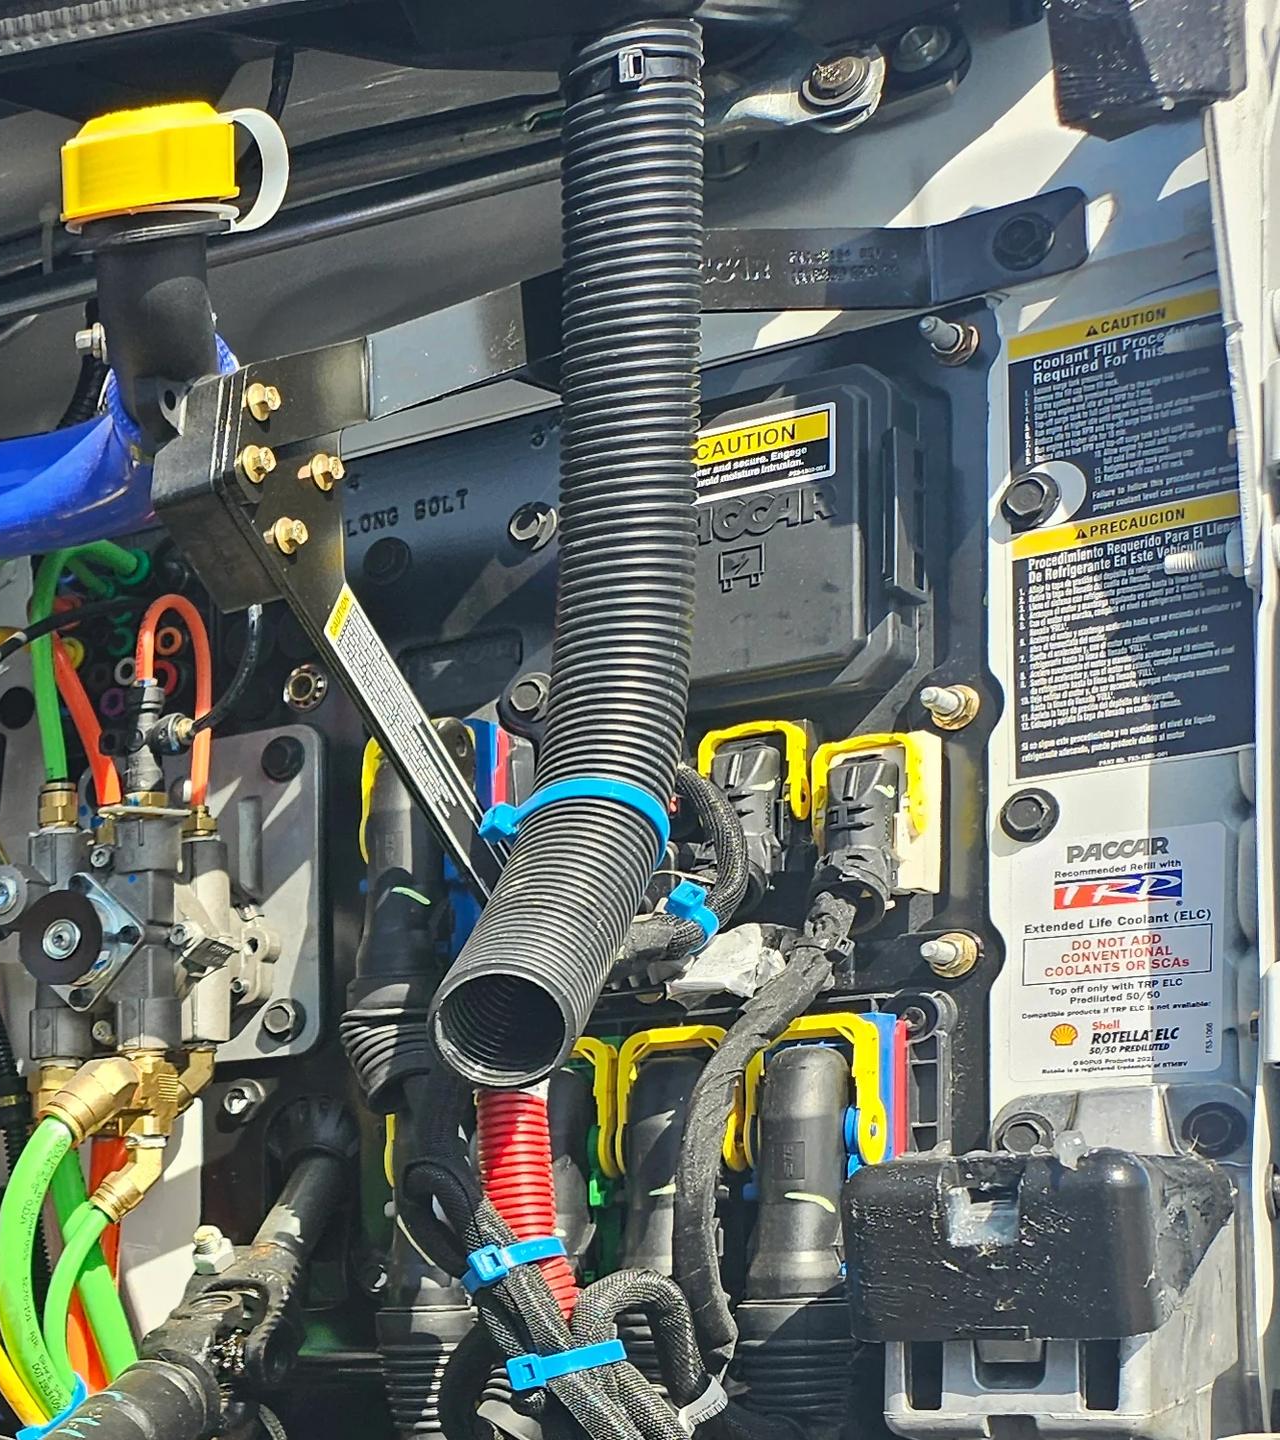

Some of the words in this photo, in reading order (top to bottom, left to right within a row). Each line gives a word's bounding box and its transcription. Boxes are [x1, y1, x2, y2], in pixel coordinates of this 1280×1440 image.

[1101, 307, 1166, 333] CAUTION
[1033, 347, 1089, 371] Coolant
[1093, 342, 1117, 356] Fill
[1123, 324, 1199, 349] Proce
[1033, 358, 1099, 385] Required
[1104, 353, 1128, 368] For
[1133, 345, 1164, 361] This
[696, 424, 796, 460] CAUTION
[713, 461, 731, 473] and
[771, 447, 807, 462] Engage
[720, 465, 760, 482] moisture
[345, 506, 399, 538] LONG
[697, 483, 838, 547] ACCAR
[1090, 508, 1185, 537] PRECAUCION
[1028, 547, 1103, 571] Procedimiento
[1107, 537, 1162, 556] Requerido
[1165, 529, 1190, 543] Para
[1193, 526, 1203, 538] El
[1207, 521, 1239, 535] Llena
[1028, 570, 1043, 585] De
[1045, 560, 1111, 580] Refrigerante
[1114, 555, 1127, 567] En
[1131, 551, 1153, 564] Este
[1067, 836, 1169, 864] PACCAR
[1054, 864, 1126, 879] Recommended
[1130, 862, 1156, 872] Refill
[1159, 859, 1182, 869] with
[1063, 874, 1182, 906] TRP
[1024, 920, 1084, 934] Extended
[1089, 917, 1112, 928] Life
[1117, 912, 1169, 926] Coolant
[1174, 909, 1211, 923] (ELC)
[1061, 946, 1173, 964] CONVENTIONAL
[1072, 940, 1094, 951] DO
[1097, 937, 1126, 948] NOT
[1131, 934, 1162, 946] ADD
[1045, 963, 1120, 977] COOLANTS
[1126, 960, 1146, 971] OR
[1151, 957, 1190, 969] SCAs
[1049, 986, 1067, 997] Top
[1070, 985, 1086, 994] off
[1088, 982, 1109, 995] only
[1112, 981, 1135, 991] with
[1138, 979, 1159, 989] TRP
[1162, 978, 1183, 988] ELC
[1070, 992, 1123, 1004] Prediluted
[1126, 990, 1160, 1001] 50/50
[1022, 1011, 1064, 1020] Compatible
[1067, 1008, 1100, 1017] products
[1112, 1005, 1127, 1013] TRP
[1130, 1004, 1144, 1012] ELC
[1092, 1019, 1120, 1030] Shell
[1091, 1030, 1149, 1045] ROTELLA
[1155, 1027, 1180, 1041] ELC
[1119, 1043, 1170, 1053] PREDILUTED
